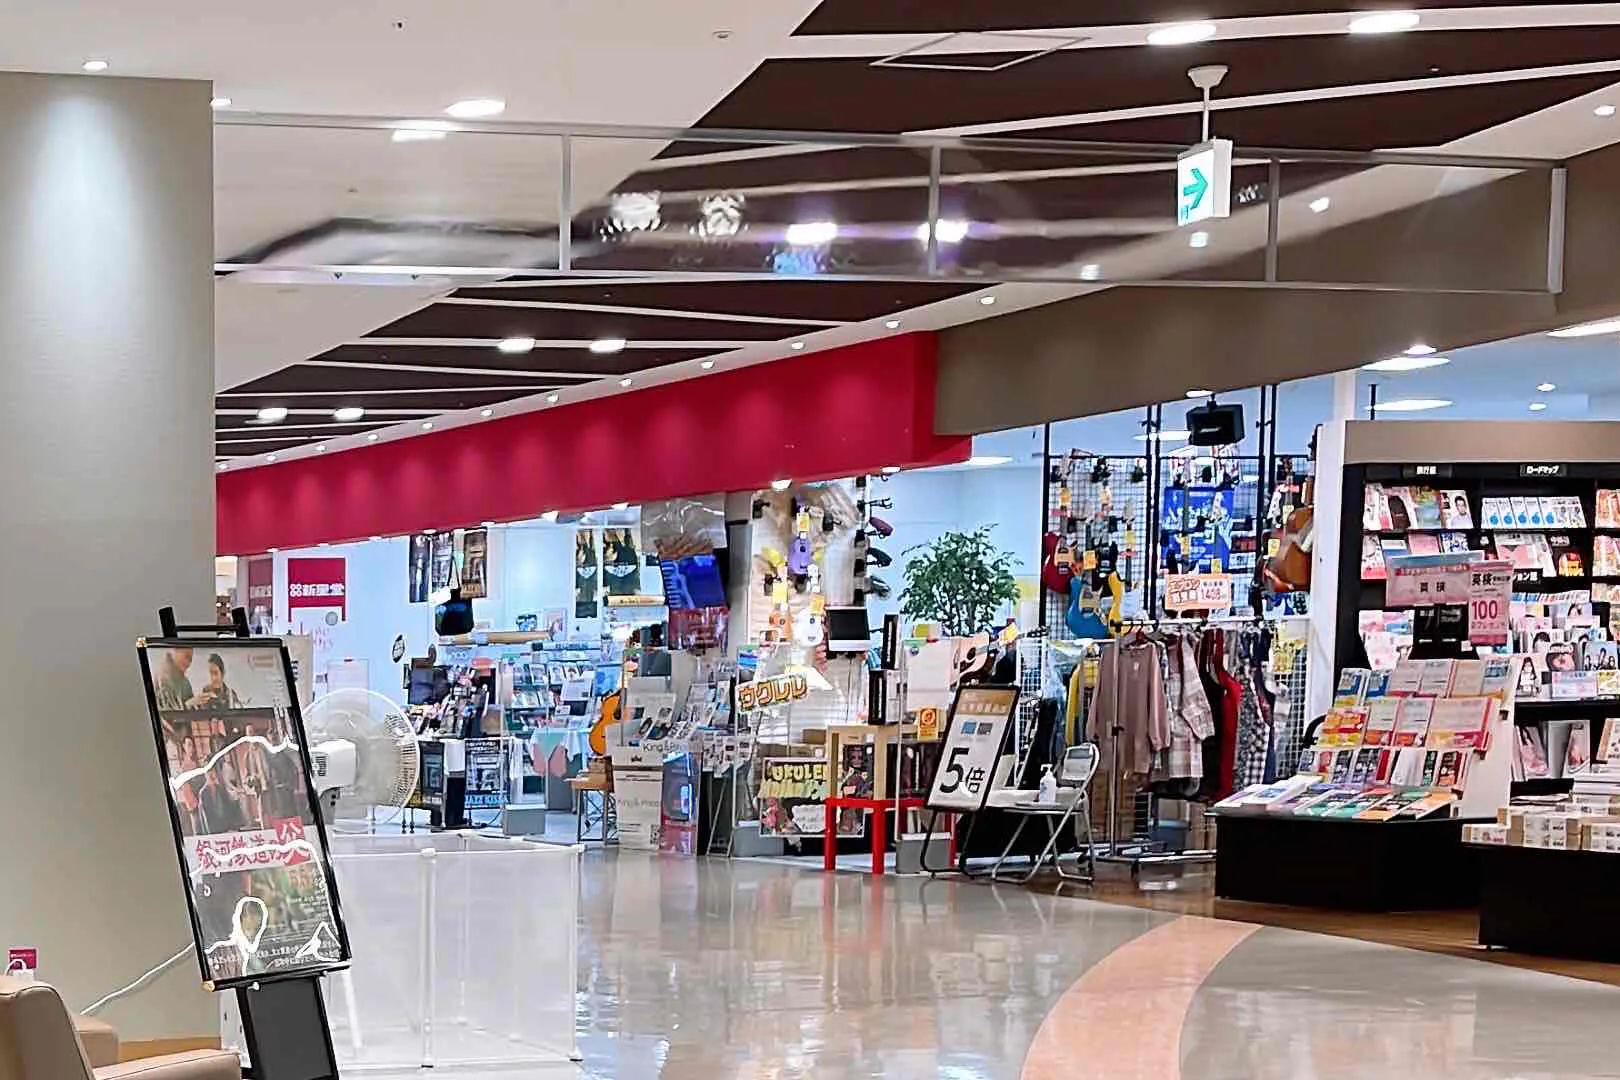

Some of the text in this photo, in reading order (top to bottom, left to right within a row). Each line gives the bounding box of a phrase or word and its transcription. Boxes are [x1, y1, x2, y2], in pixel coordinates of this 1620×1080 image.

[1472, 599, 1498, 620] 100
[739, 675, 808, 711] ウクレレ
